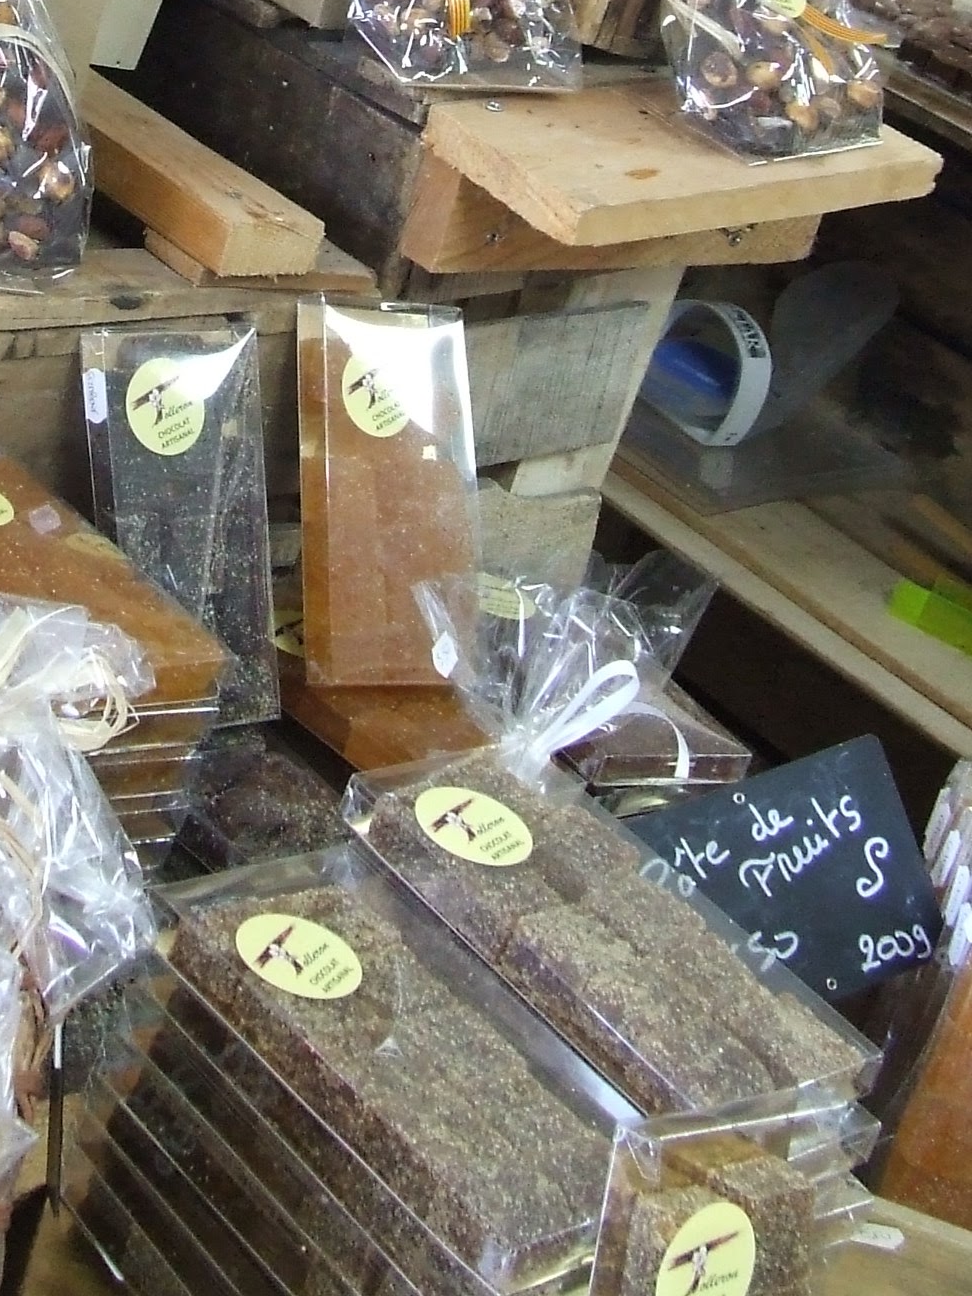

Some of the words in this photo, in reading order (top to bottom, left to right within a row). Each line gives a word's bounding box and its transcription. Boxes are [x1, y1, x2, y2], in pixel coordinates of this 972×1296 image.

[157, 416, 191, 440] CHOCOLAT
[160, 427, 196, 450] ARTISANAL
[748, 802, 795, 842] de
